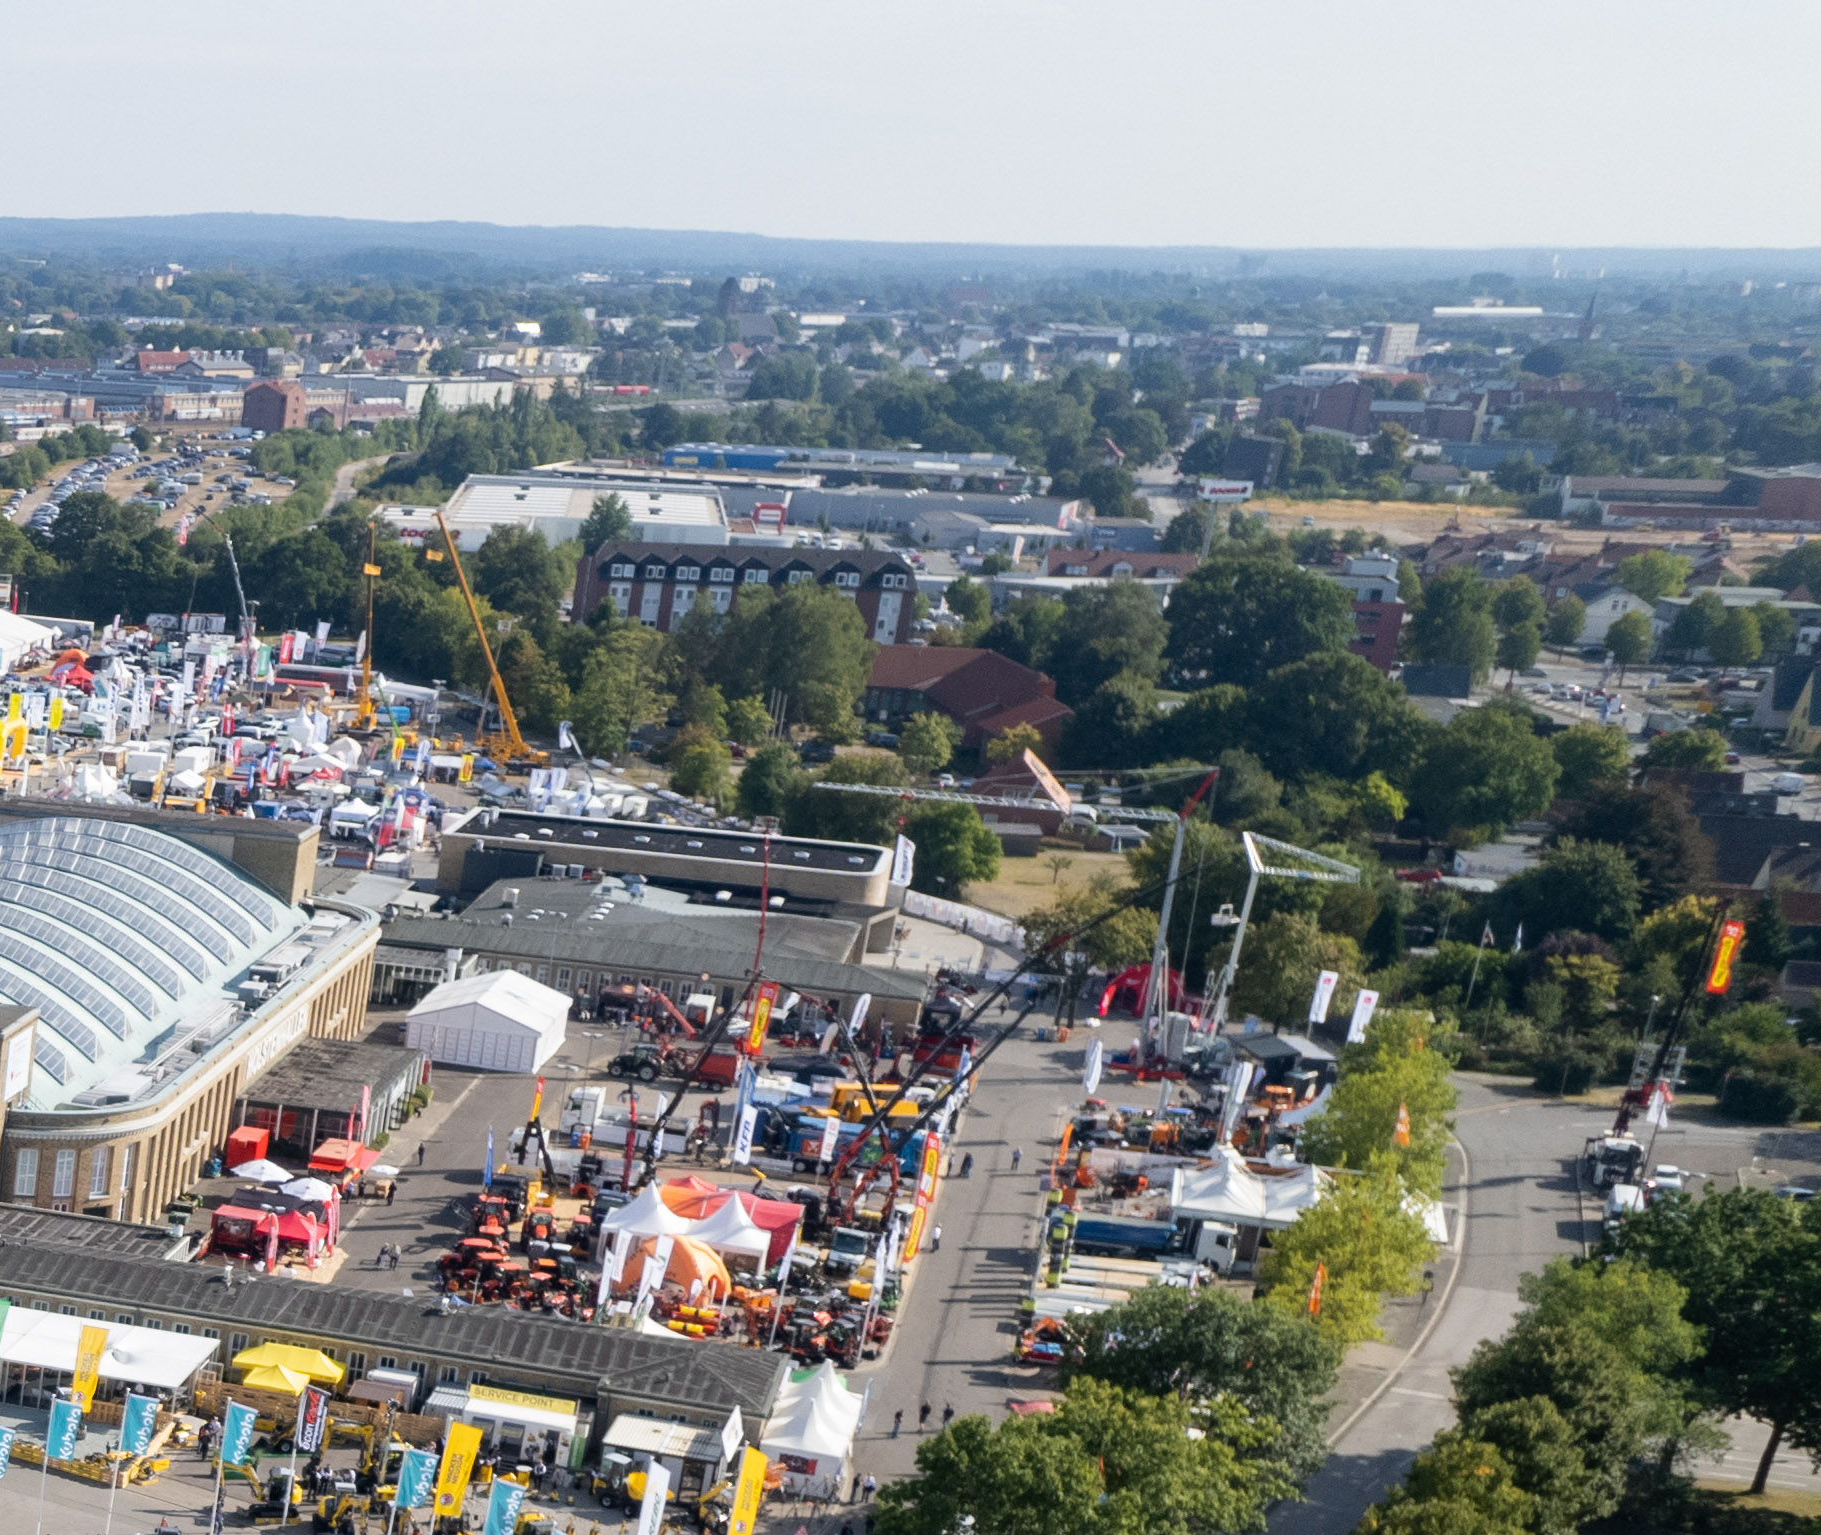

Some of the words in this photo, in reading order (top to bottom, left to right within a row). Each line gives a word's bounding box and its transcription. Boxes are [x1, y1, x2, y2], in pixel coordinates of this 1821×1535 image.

[474, 1385, 518, 1402] SERVICE
[521, 1395, 555, 1409] POINT
[59, 1408, 82, 1461] Kubota
[134, 1402, 158, 1456] Kubota
[232, 1413, 255, 1465] Kubota
[409, 1458, 436, 1508] Kubota
